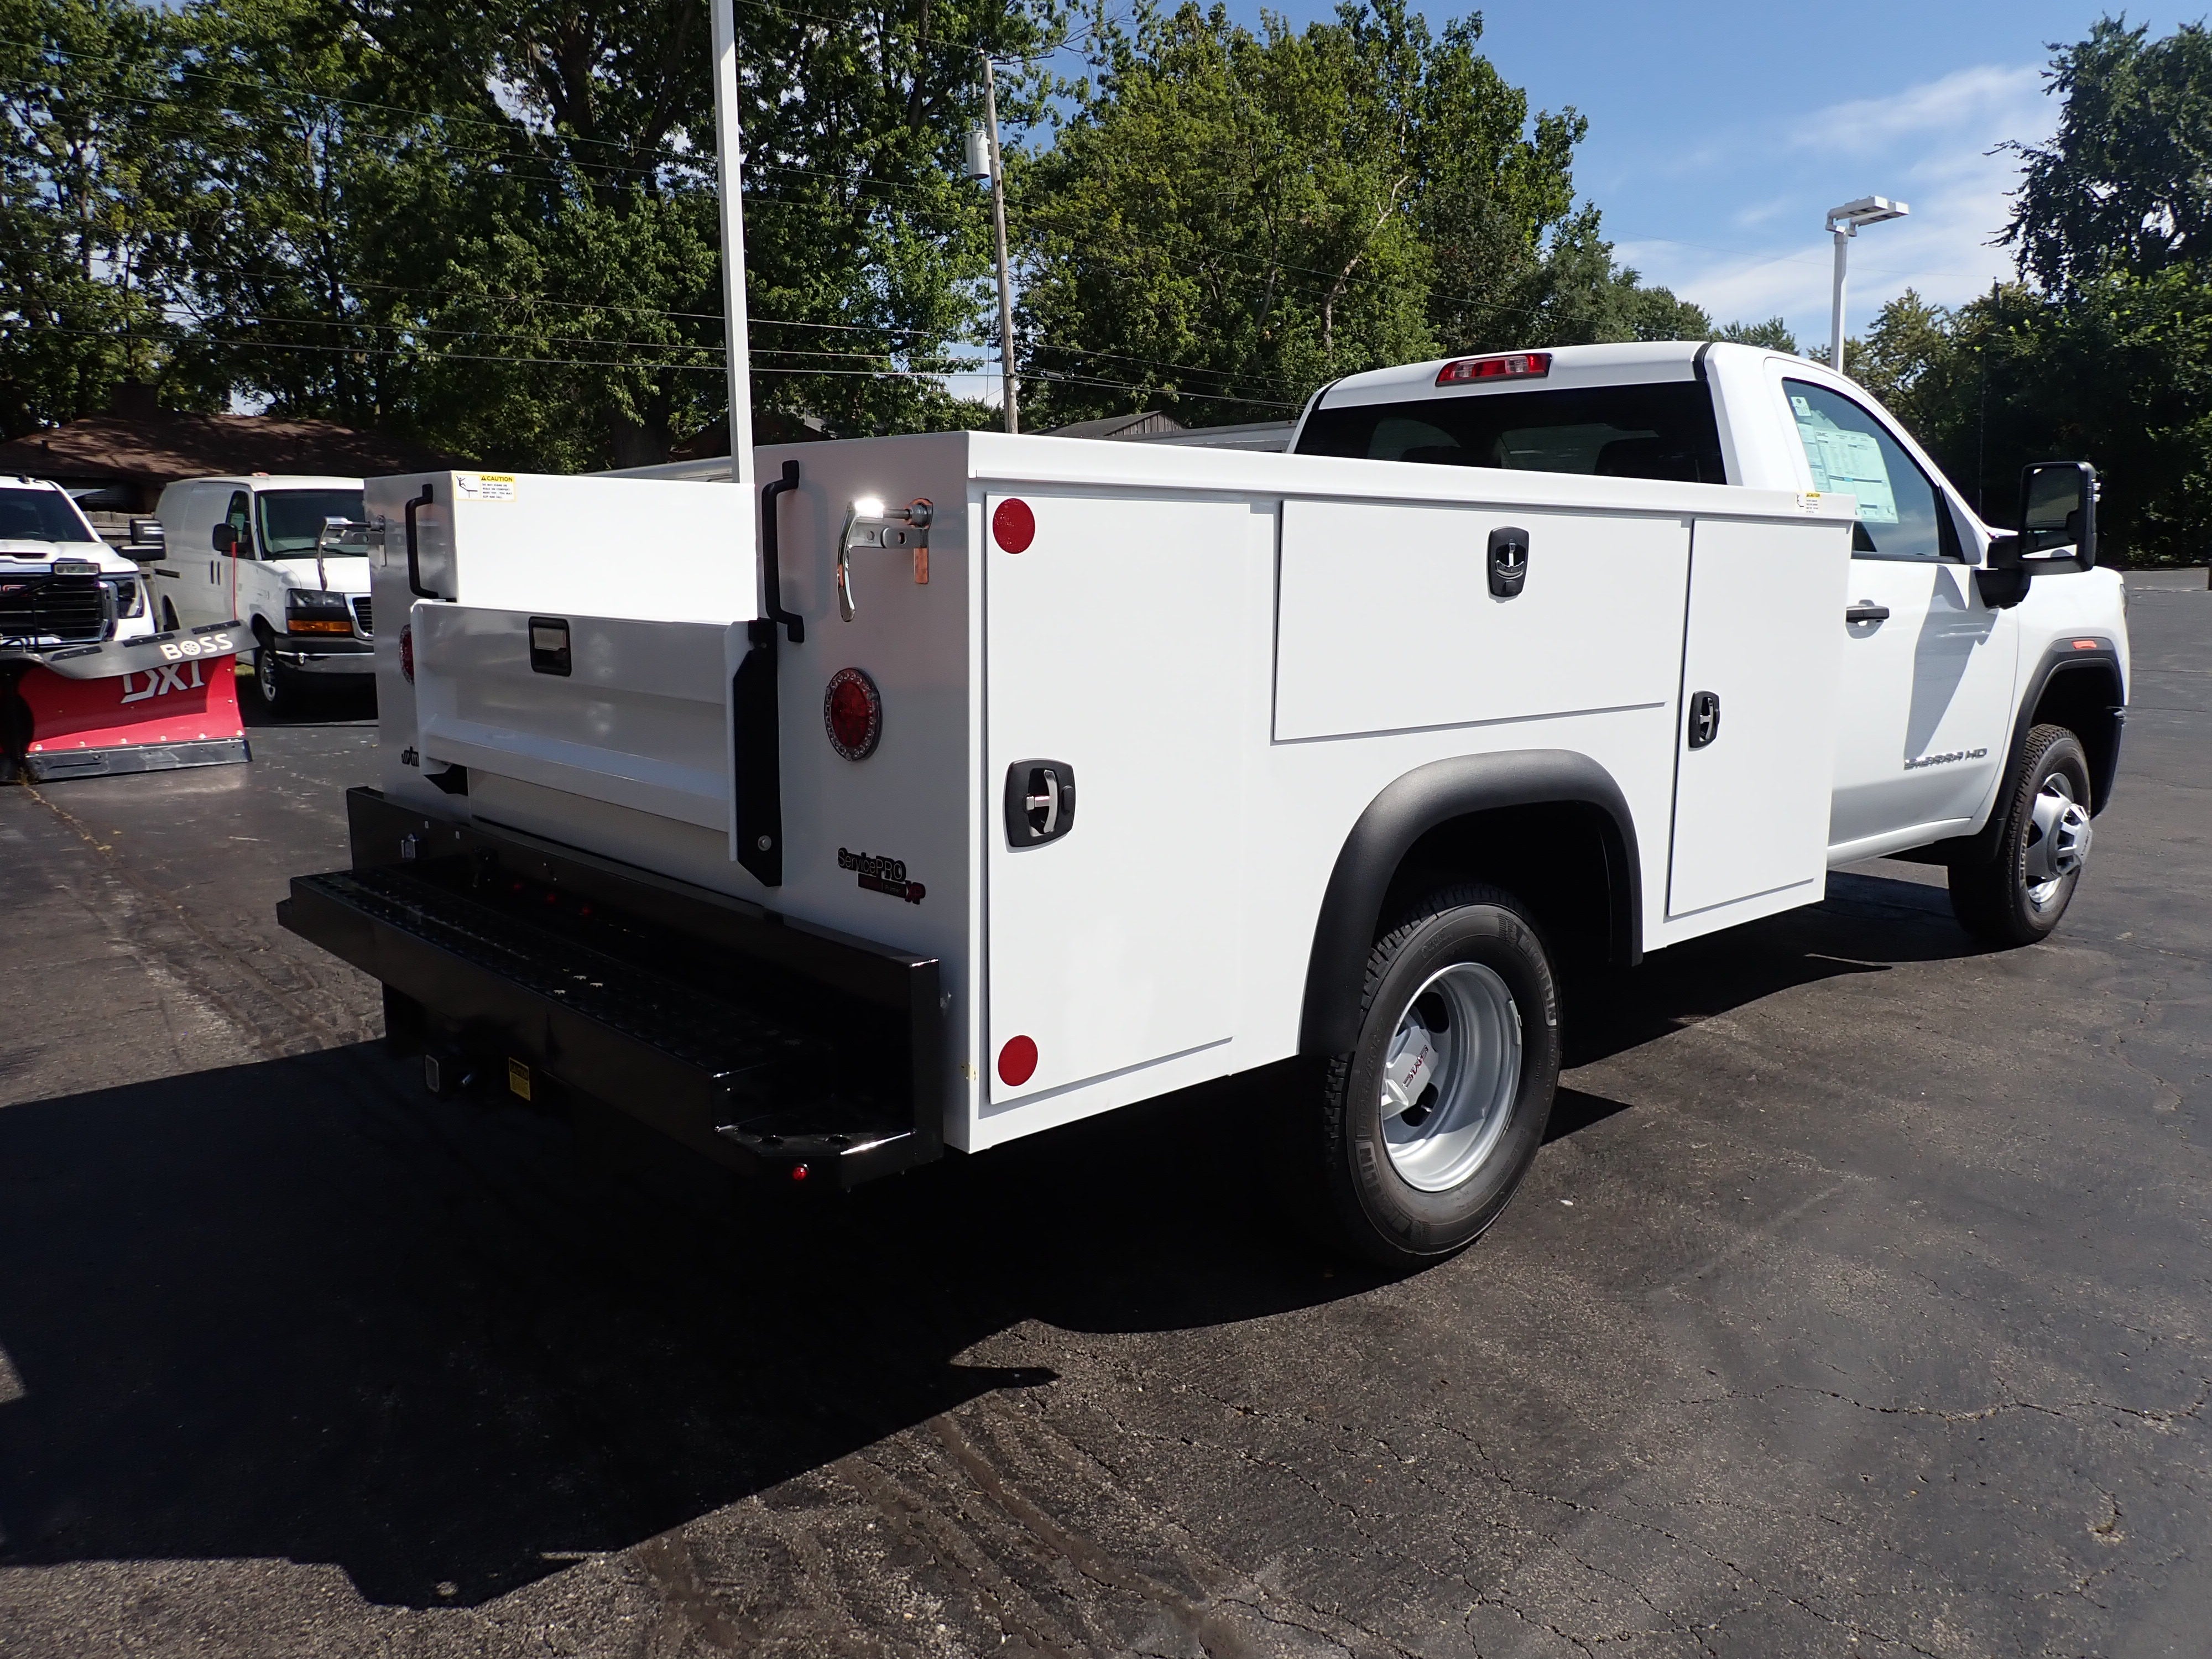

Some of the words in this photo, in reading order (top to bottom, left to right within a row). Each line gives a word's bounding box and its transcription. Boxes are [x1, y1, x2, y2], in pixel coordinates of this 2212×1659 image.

[159, 633, 233, 660] BOSS
[1964, 748, 1987, 760] HD
[838, 848, 905, 881] ServicePRO
[1402, 1044, 1429, 1091] GMC
